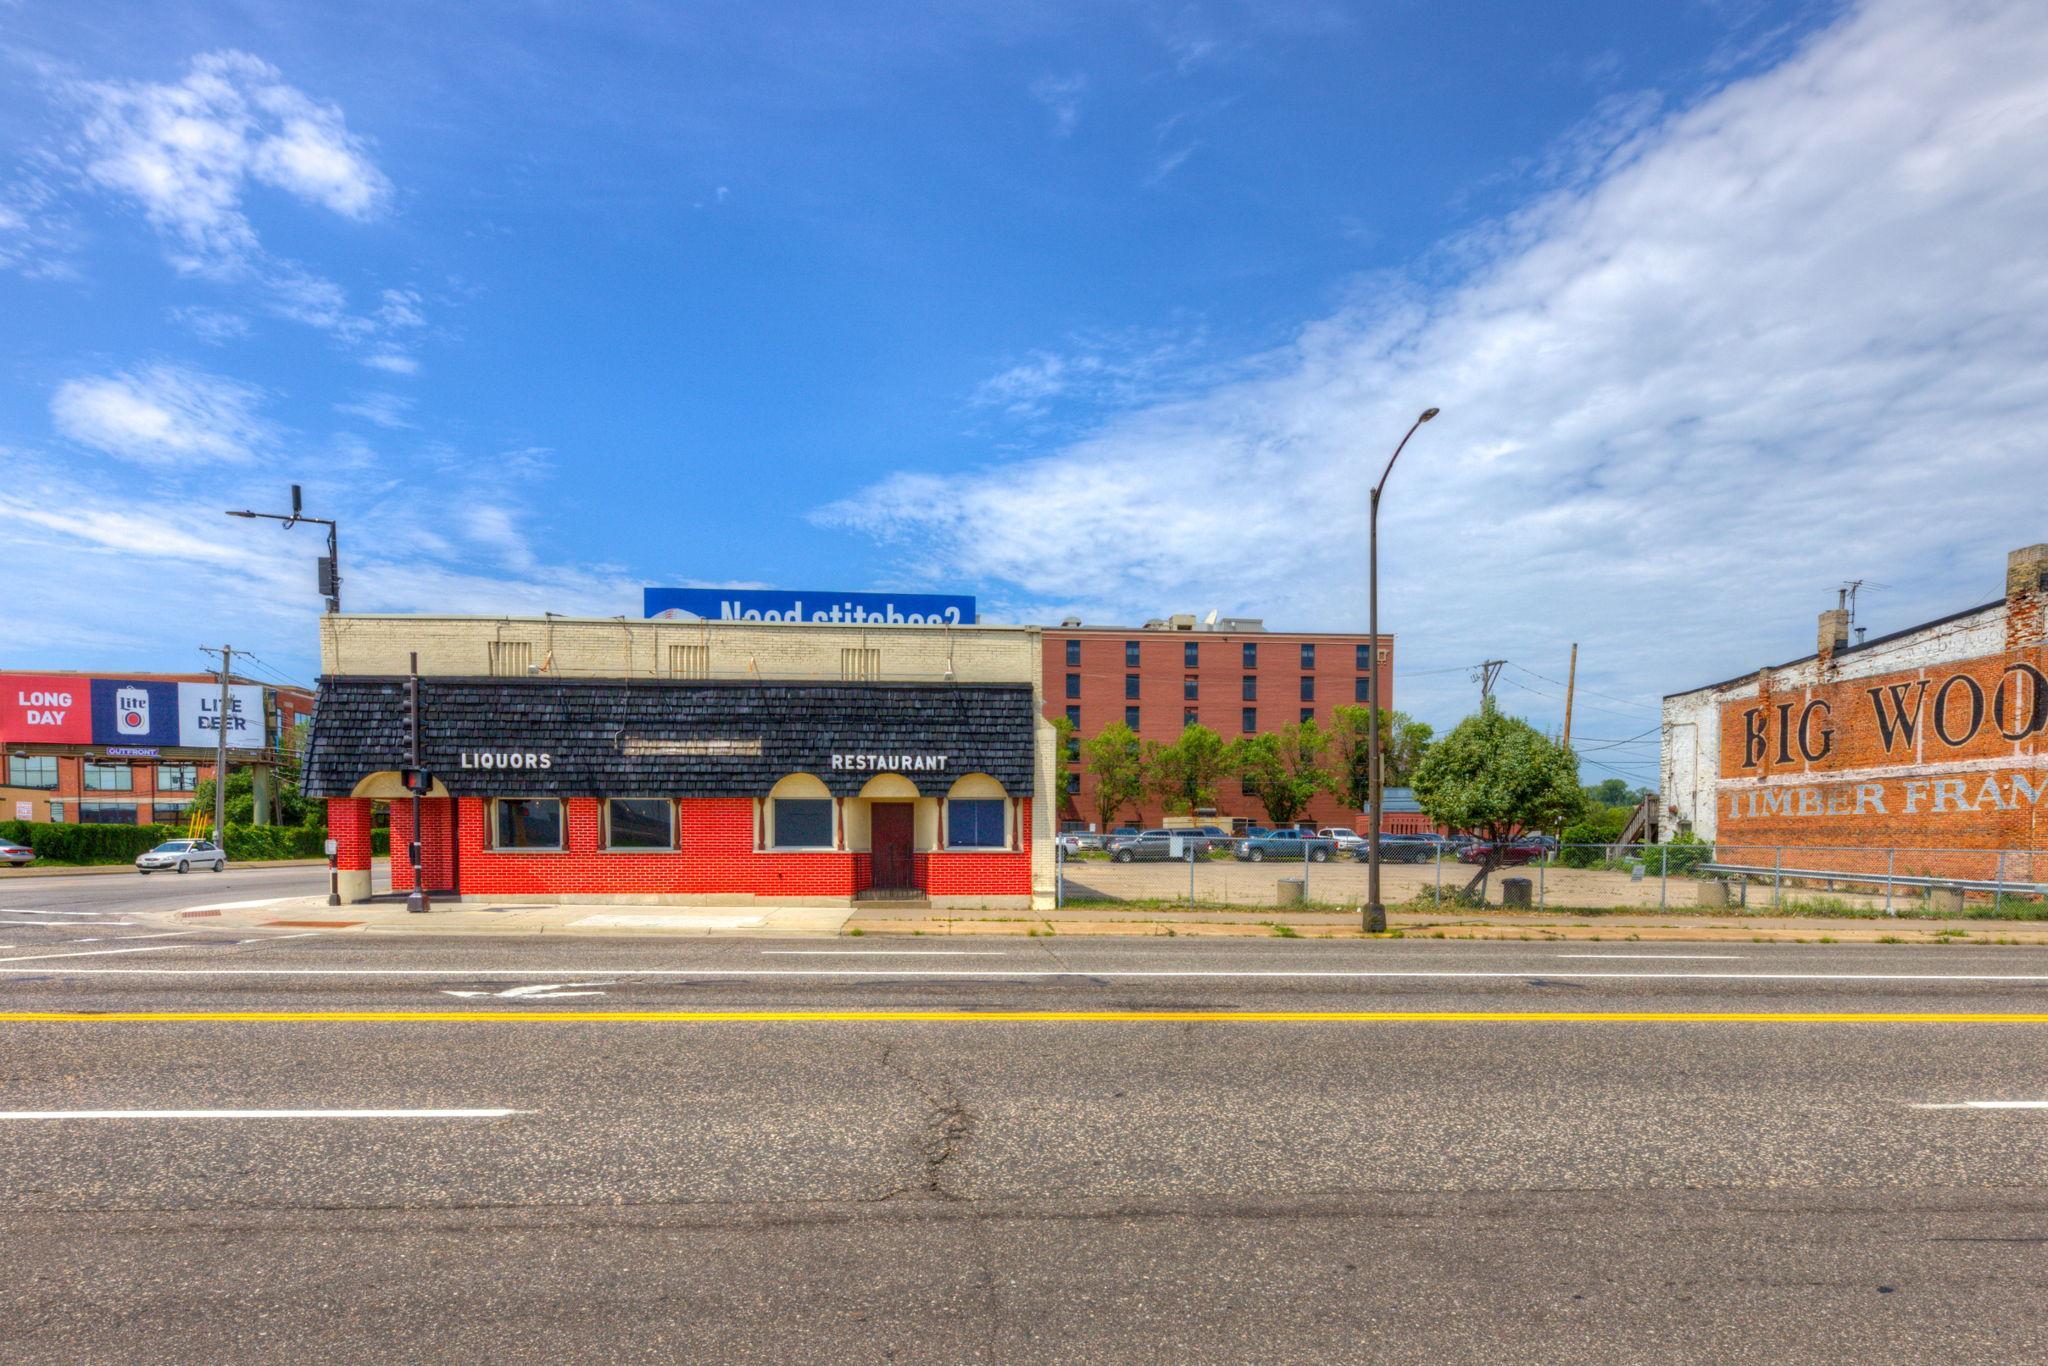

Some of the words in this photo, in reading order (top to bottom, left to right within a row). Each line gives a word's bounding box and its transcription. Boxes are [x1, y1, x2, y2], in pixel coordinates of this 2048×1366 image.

[18, 691, 73, 708] LONG
[120, 697, 146, 711] Lite
[201, 698, 242, 712] LIE
[27, 710, 66, 726] DAY
[198, 716, 246, 730] BEER
[1742, 700, 1835, 769] BIG
[108, 747, 158, 756] OUTFRONT
[461, 753, 552, 770] LIQUORS
[832, 754, 948, 771] RESTAURANT
[1727, 783, 1889, 820] TIMBER
